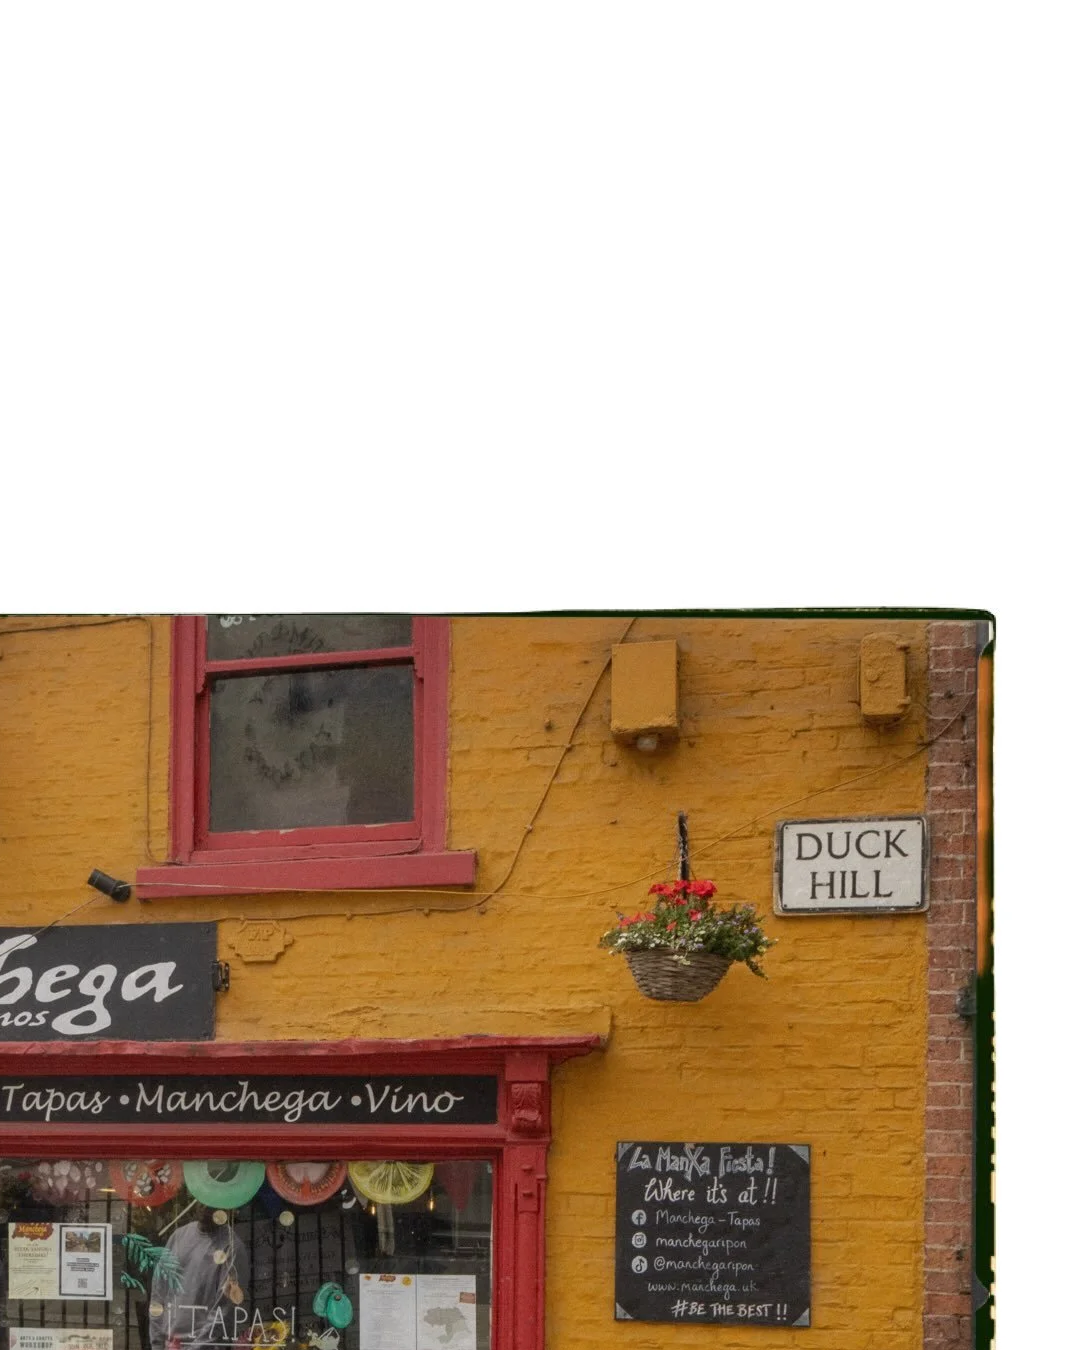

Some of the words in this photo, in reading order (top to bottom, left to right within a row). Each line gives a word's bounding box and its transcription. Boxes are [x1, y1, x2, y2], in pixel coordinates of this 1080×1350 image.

[796, 829, 909, 860] DUCK
[810, 870, 893, 900] HILL
[1, 1083, 112, 1122] Tapas
[134, 1080, 342, 1123] Manchega
[366, 1082, 465, 1114] Vino
[629, 1147, 652, 1170] La
[644, 1177, 696, 1203] Where
[706, 1176, 728, 1204] it's
[655, 1233, 747, 1256] manchegaripon
[653, 1255, 755, 1280] @manchegaripon
[647, 1280, 758, 1301] www.manchega.uk
[671, 1300, 707, 1318] #BE
[709, 1303, 735, 1318] THE
[737, 1303, 773, 1318] BEST
